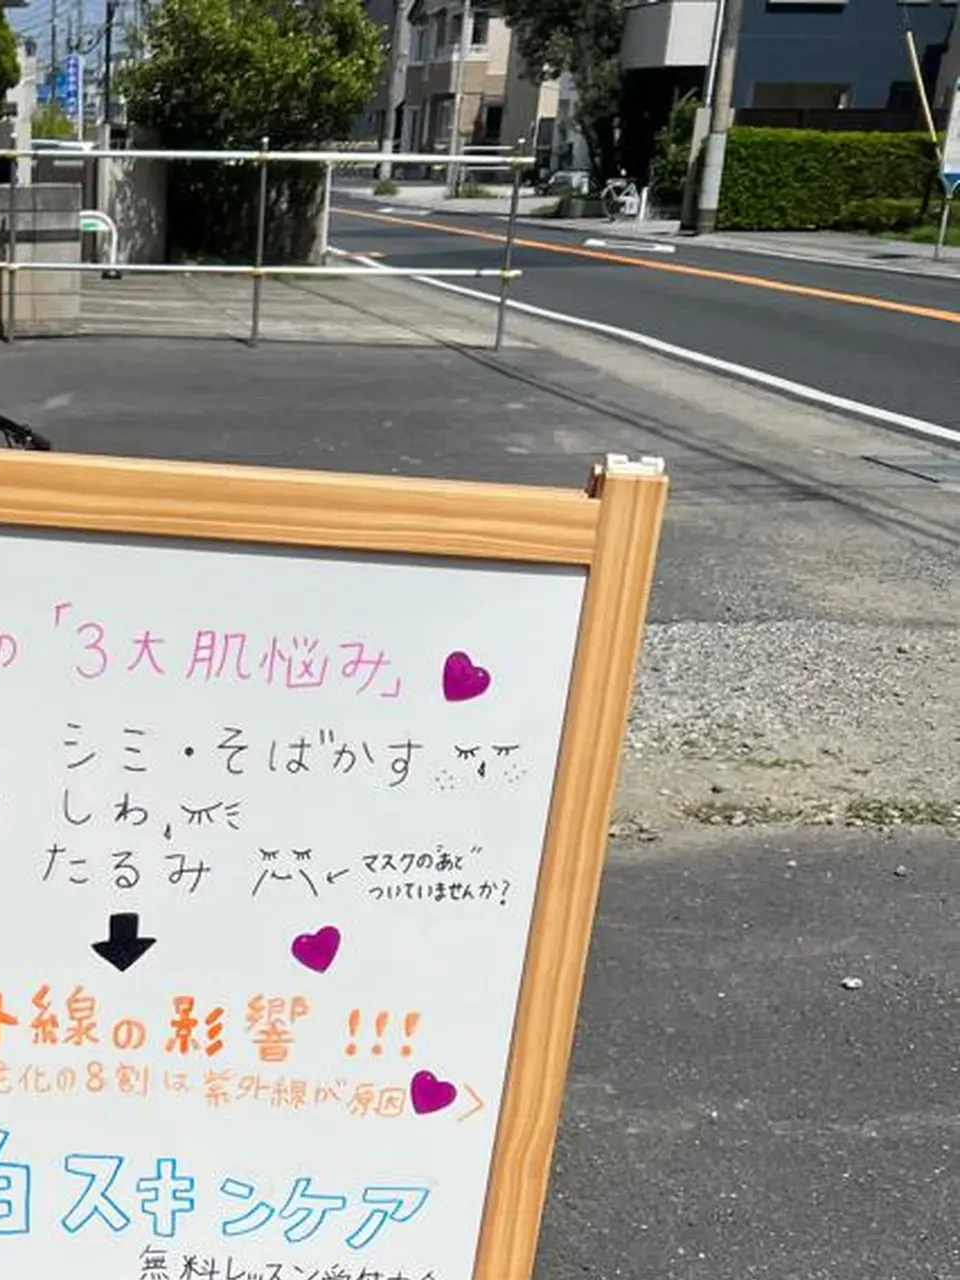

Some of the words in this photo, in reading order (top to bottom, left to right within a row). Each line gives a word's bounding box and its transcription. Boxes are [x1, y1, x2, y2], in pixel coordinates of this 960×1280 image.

[63, 722, 424, 787] シミ・そばかす
[62, 788, 149, 827] しわ
[41, 840, 212, 894] たるみ
